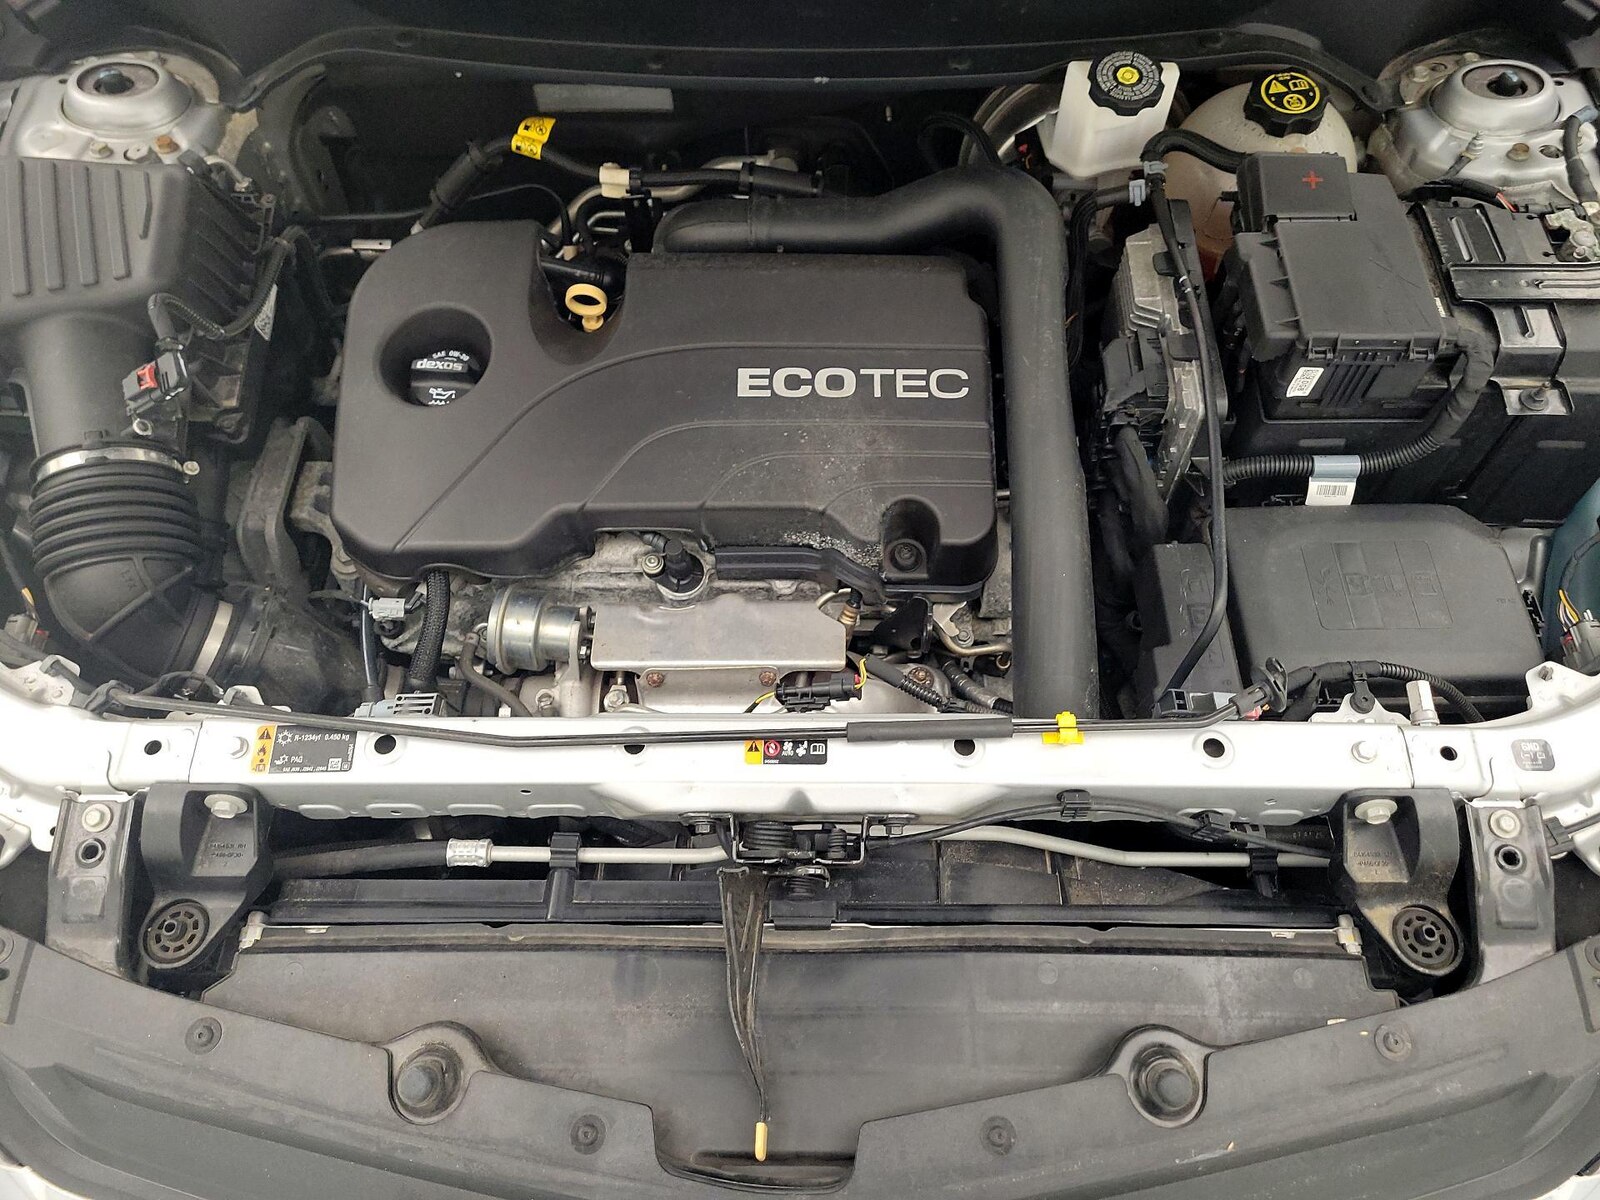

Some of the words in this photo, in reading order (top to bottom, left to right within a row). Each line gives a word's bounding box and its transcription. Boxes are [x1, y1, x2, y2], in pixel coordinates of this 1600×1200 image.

[416, 358, 463, 371] dexos
[737, 367, 970, 399] ECOTEC
[290, 755, 303, 763] PAG
